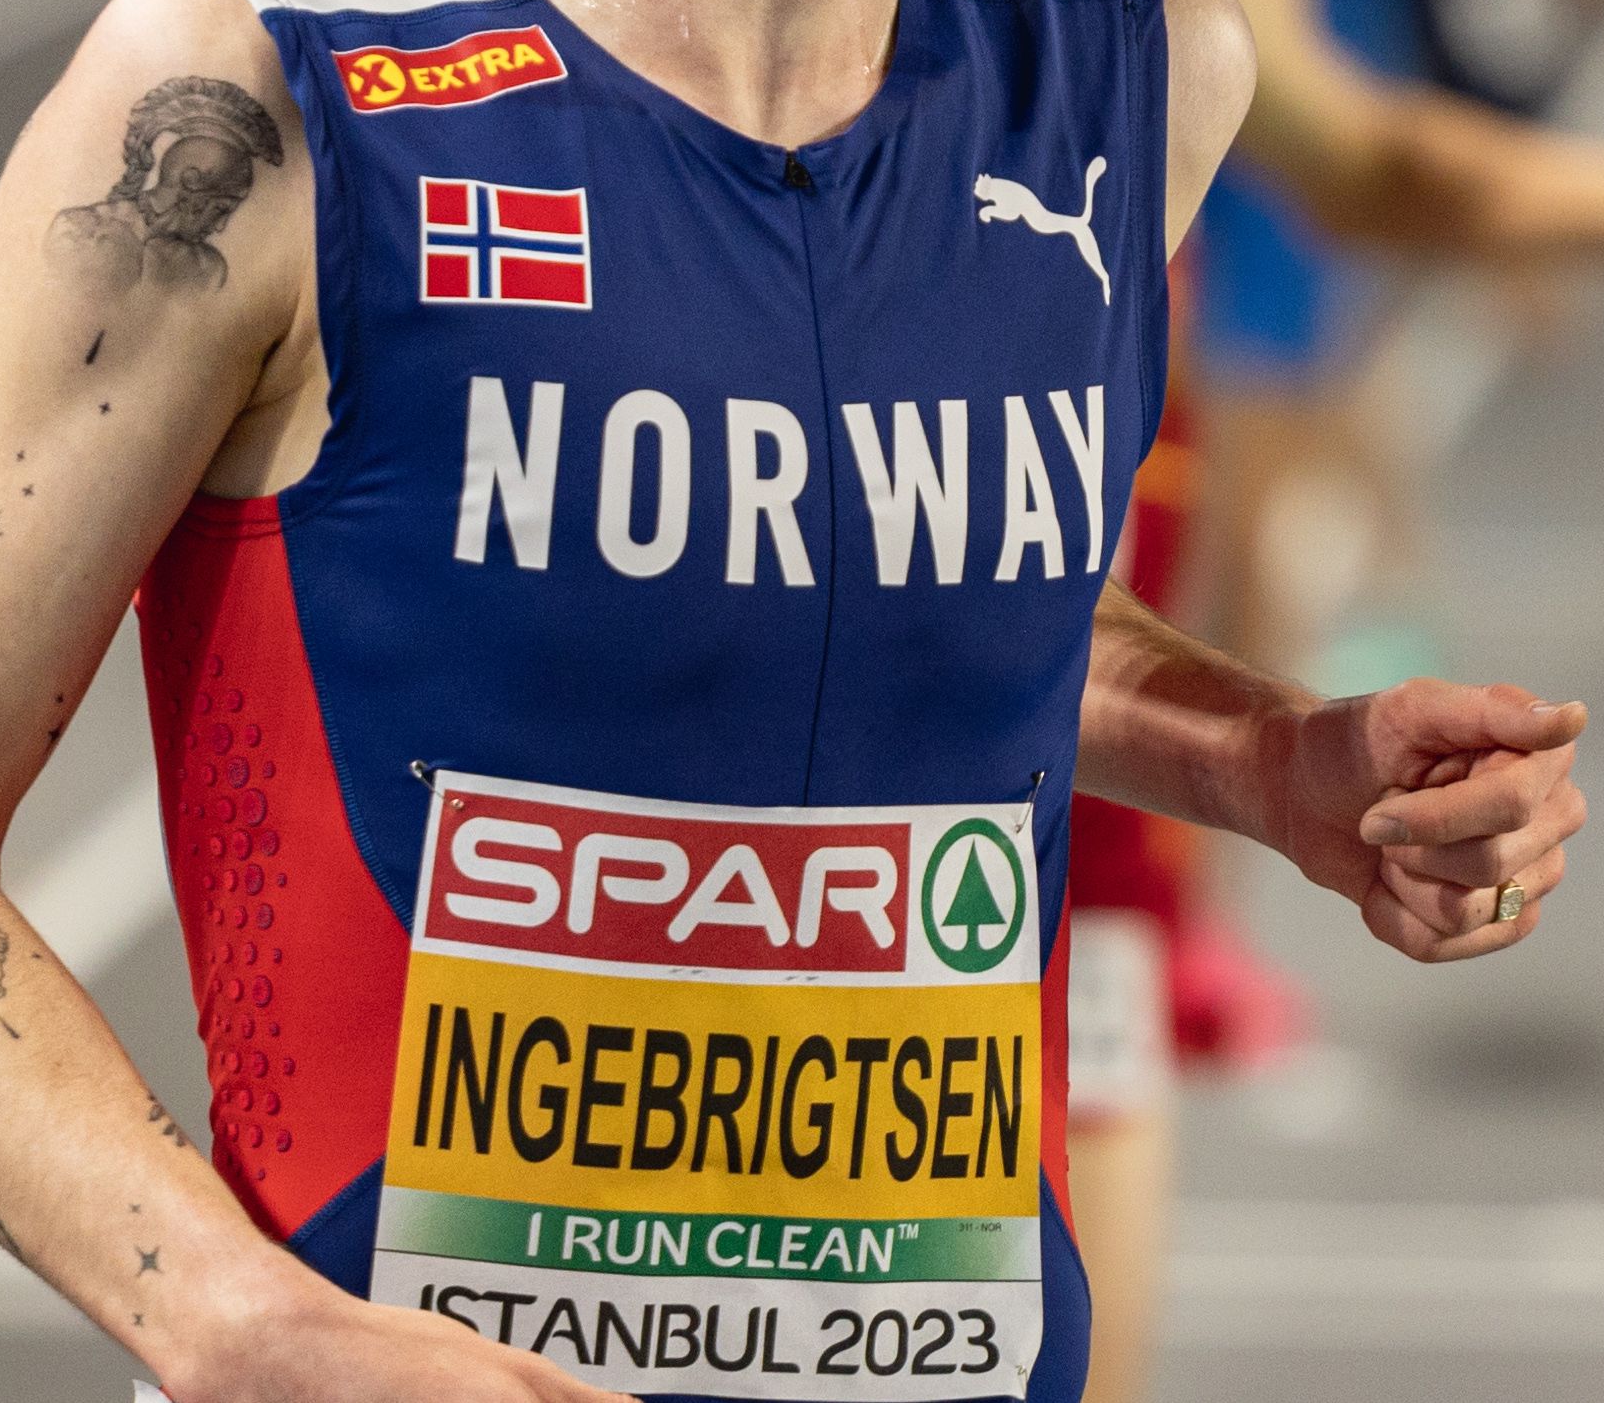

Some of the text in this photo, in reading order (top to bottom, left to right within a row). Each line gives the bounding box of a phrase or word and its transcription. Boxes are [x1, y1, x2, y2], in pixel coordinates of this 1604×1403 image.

[409, 43, 545, 92] EXTRA
[453, 377, 1105, 586] NORWAY
[444, 816, 899, 951] SPAR
[412, 1002, 1025, 1182] INGEBRIGTSEN
[526, 1211, 543, 1257] I
[562, 1214, 692, 1266] RUN
[815, 1307, 1000, 1377] 2023
